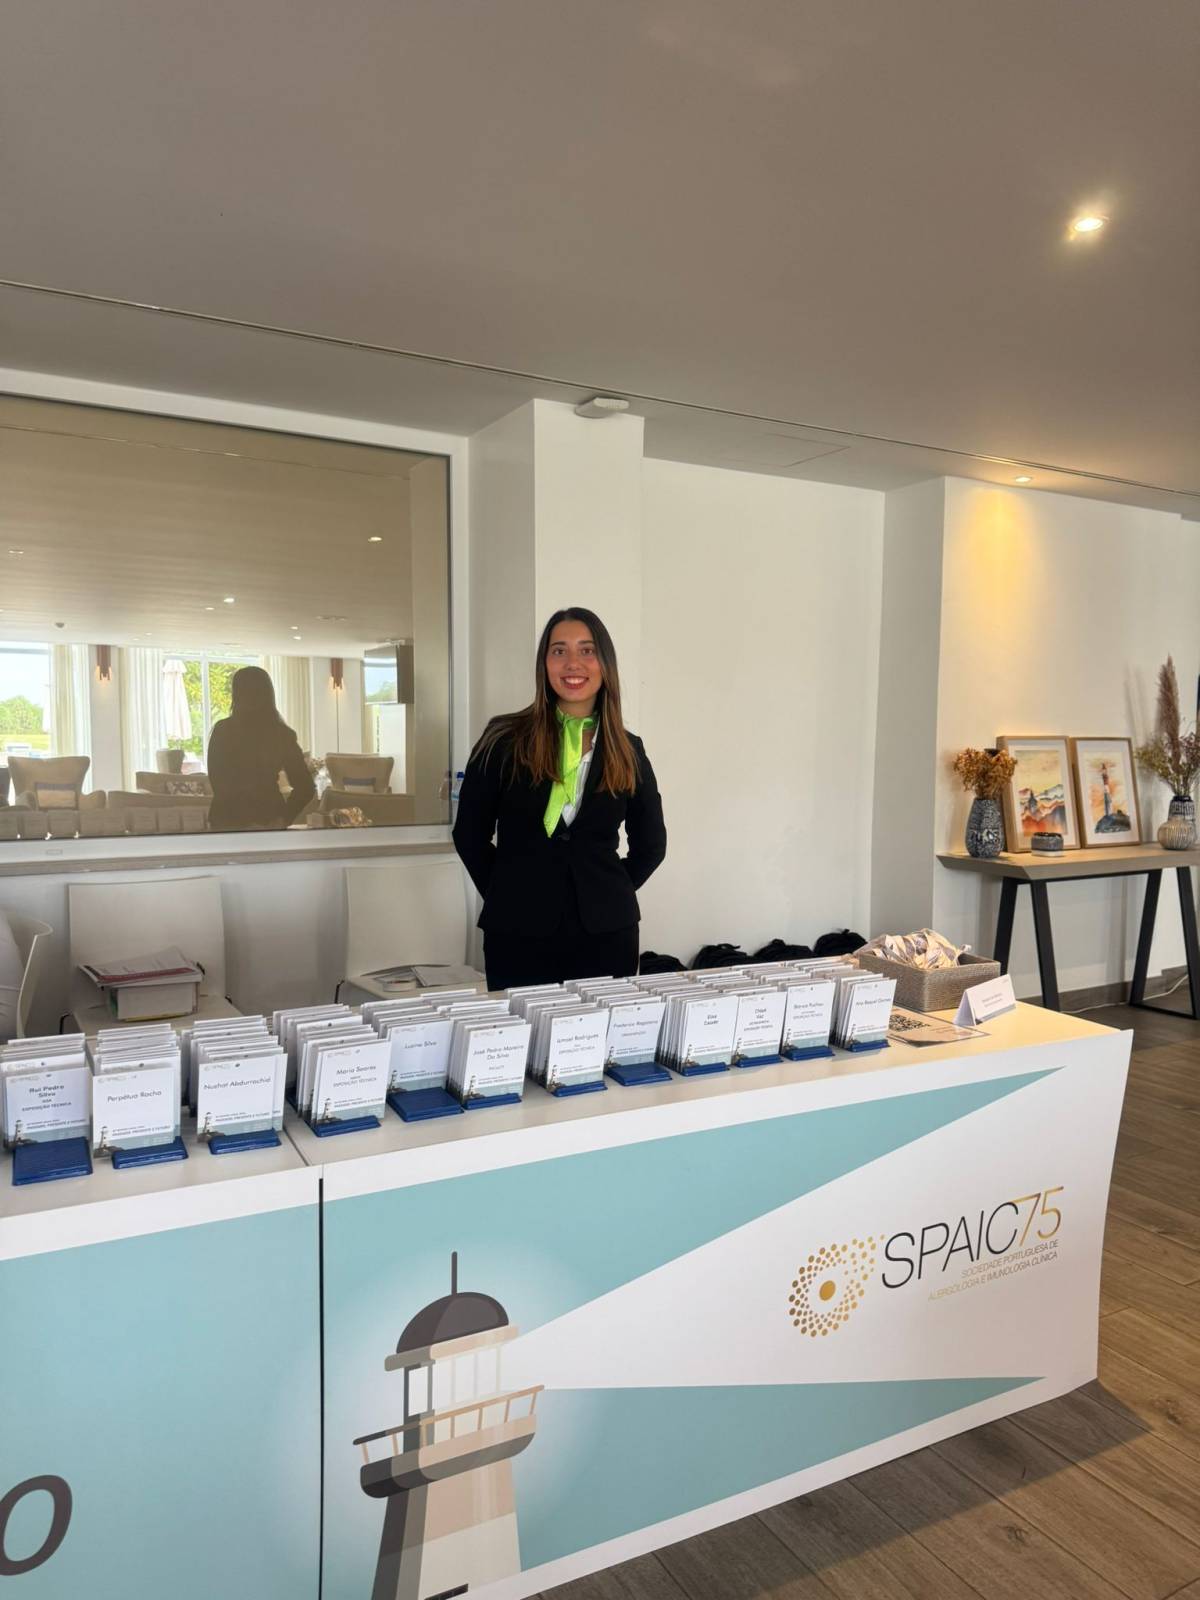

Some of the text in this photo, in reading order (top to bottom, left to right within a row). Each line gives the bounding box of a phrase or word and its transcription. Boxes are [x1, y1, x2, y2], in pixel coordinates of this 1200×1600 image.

[928, 1279, 982, 1302] ALERGOLOGIA
[987, 1261, 1031, 1282] IMUNOLOGIA
[1031, 1250, 1058, 1267] CLÍNICA
[961, 1239, 1060, 1279] SOCIEDADE PORTUGUESA DE
